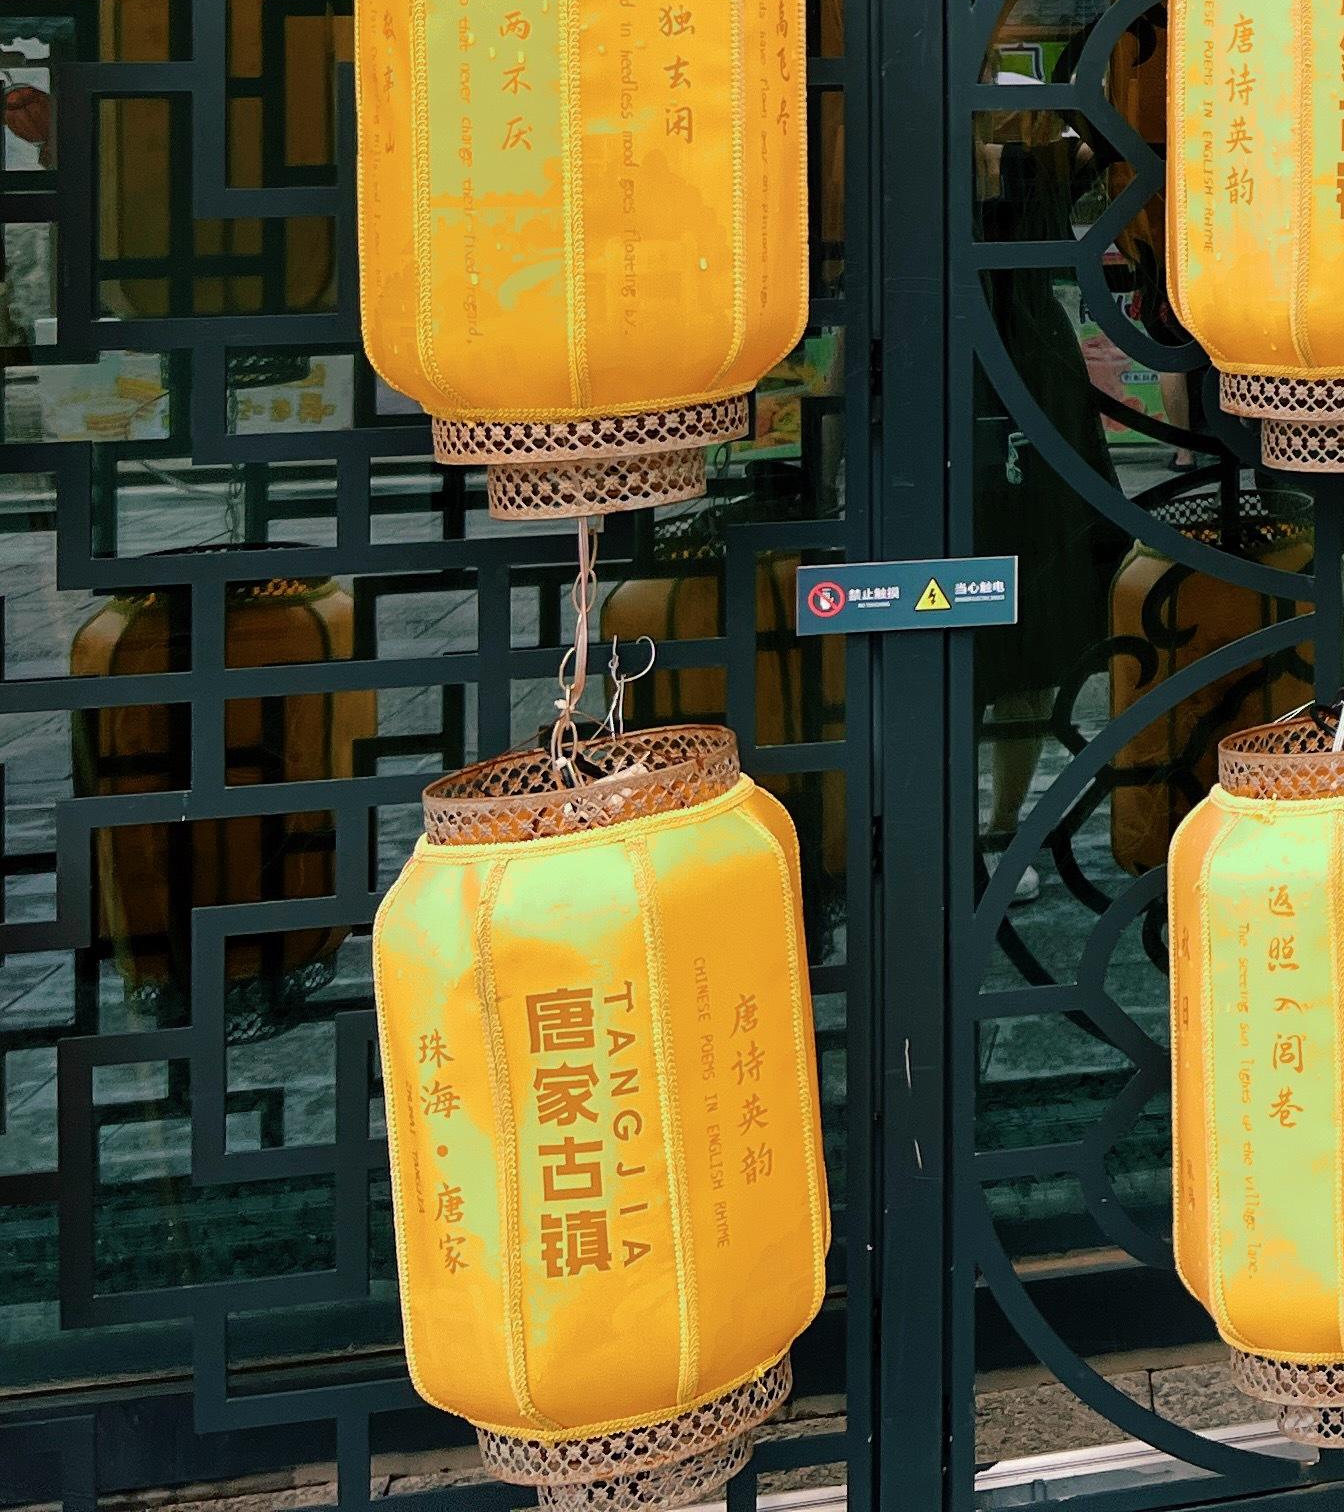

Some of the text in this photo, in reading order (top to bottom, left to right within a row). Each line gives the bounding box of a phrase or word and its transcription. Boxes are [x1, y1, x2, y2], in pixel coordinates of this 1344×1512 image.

[458, 16, 470, 51] that
[621, 22, 633, 37] in
[460, 62, 471, 104] never
[621, 51, 634, 119] heedless
[1203, 40, 1215, 85] POEMS
[1203, 100, 1214, 118] IN
[1225, 14, 1256, 206] 唐诗英韵
[458, 117, 474, 167] change
[623, 130, 637, 166] mood
[1202, 131, 1214, 195] ENGLISH
[462, 178, 474, 216] their
[620, 178, 635, 214] goes
[463, 233, 478, 273] fixed
[1203, 208, 1214, 253] RHYME
[622, 230, 640, 297] floating
[1237, 922, 1250, 946] The
[1237, 957, 1249, 1012] setting
[1267, 884, 1304, 1128] 返照入闾巷
[1239, 1023, 1249, 1047] sun
[692, 957, 730, 1249] CHINESE POEMS IN ENGLISH RHYME
[730, 993, 772, 1185] 唐诗英韵
[1238, 1059, 1254, 1104] lights
[525, 985, 612, 1278] 唐家古镇
[605, 979, 655, 1267] TANGJIA
[1242, 1115, 1252, 1132] up
[1242, 1141, 1254, 1166] the
[1244, 1176, 1260, 1230] village
